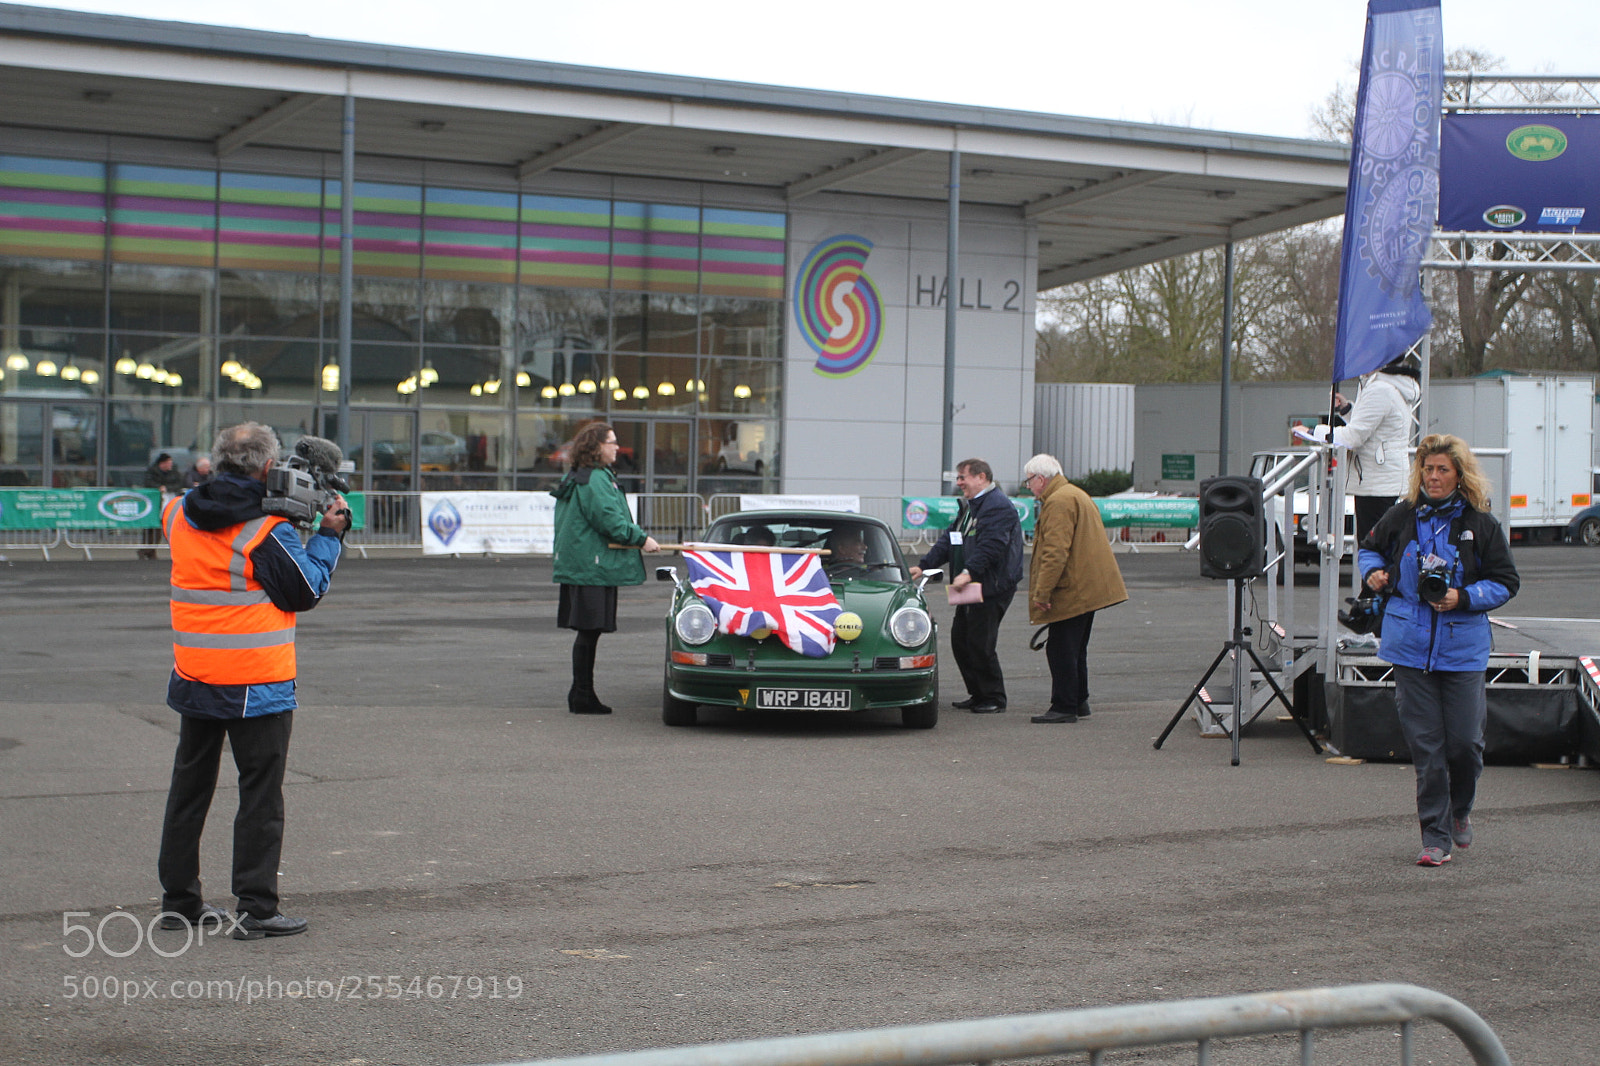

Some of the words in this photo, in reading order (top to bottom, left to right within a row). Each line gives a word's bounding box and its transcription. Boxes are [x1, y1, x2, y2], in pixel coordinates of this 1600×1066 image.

[1002, 280, 1021, 311] 2
[762, 690, 798, 707] WRP
[803, 691, 846, 708] 184H
